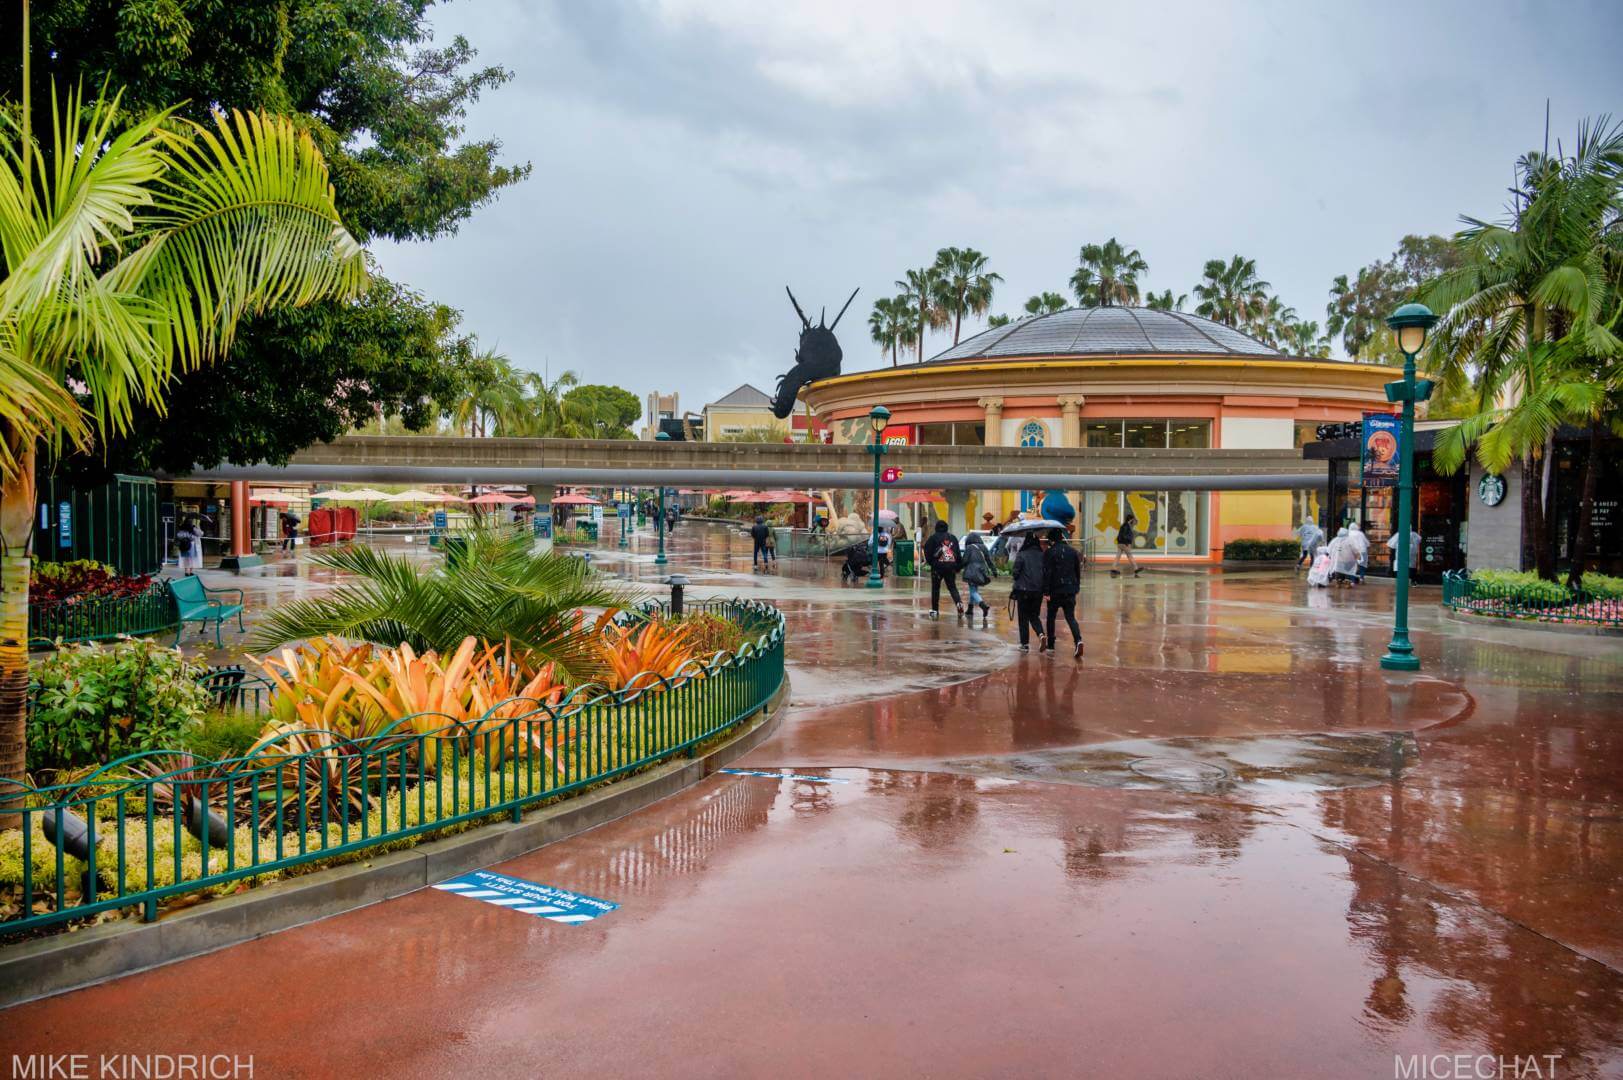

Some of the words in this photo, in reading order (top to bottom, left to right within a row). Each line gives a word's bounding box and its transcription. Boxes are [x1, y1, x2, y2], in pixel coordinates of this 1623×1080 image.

[481, 882, 524, 894] SAFETY
[522, 892, 552, 903] YOUR
[553, 900, 578, 910] FOR
